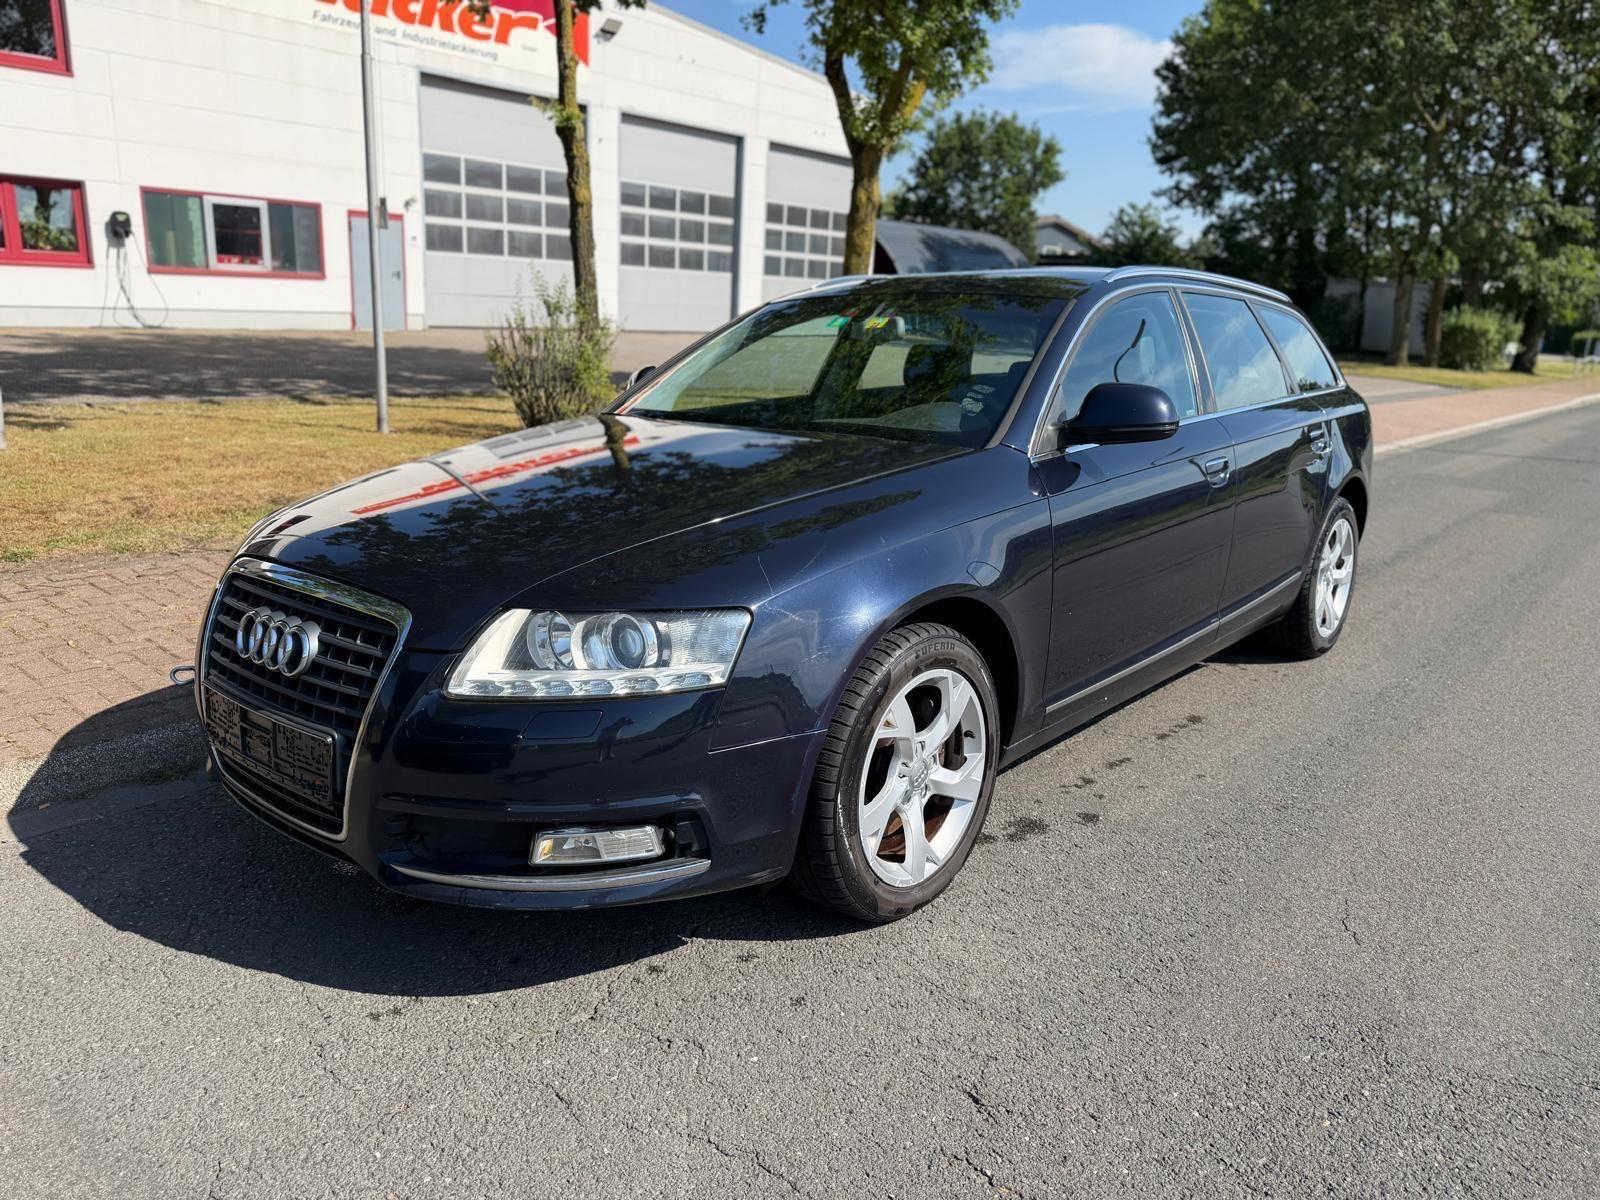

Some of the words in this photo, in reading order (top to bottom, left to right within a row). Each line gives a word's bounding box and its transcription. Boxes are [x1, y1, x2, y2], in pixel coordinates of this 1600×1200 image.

[312, 9, 364, 30] Fahrzeu
[374, 26, 397, 37] und
[401, 30, 499, 61] Industrielackierung
[313, 0, 540, 46] cker
[914, 641, 956, 660] SUPERIA
